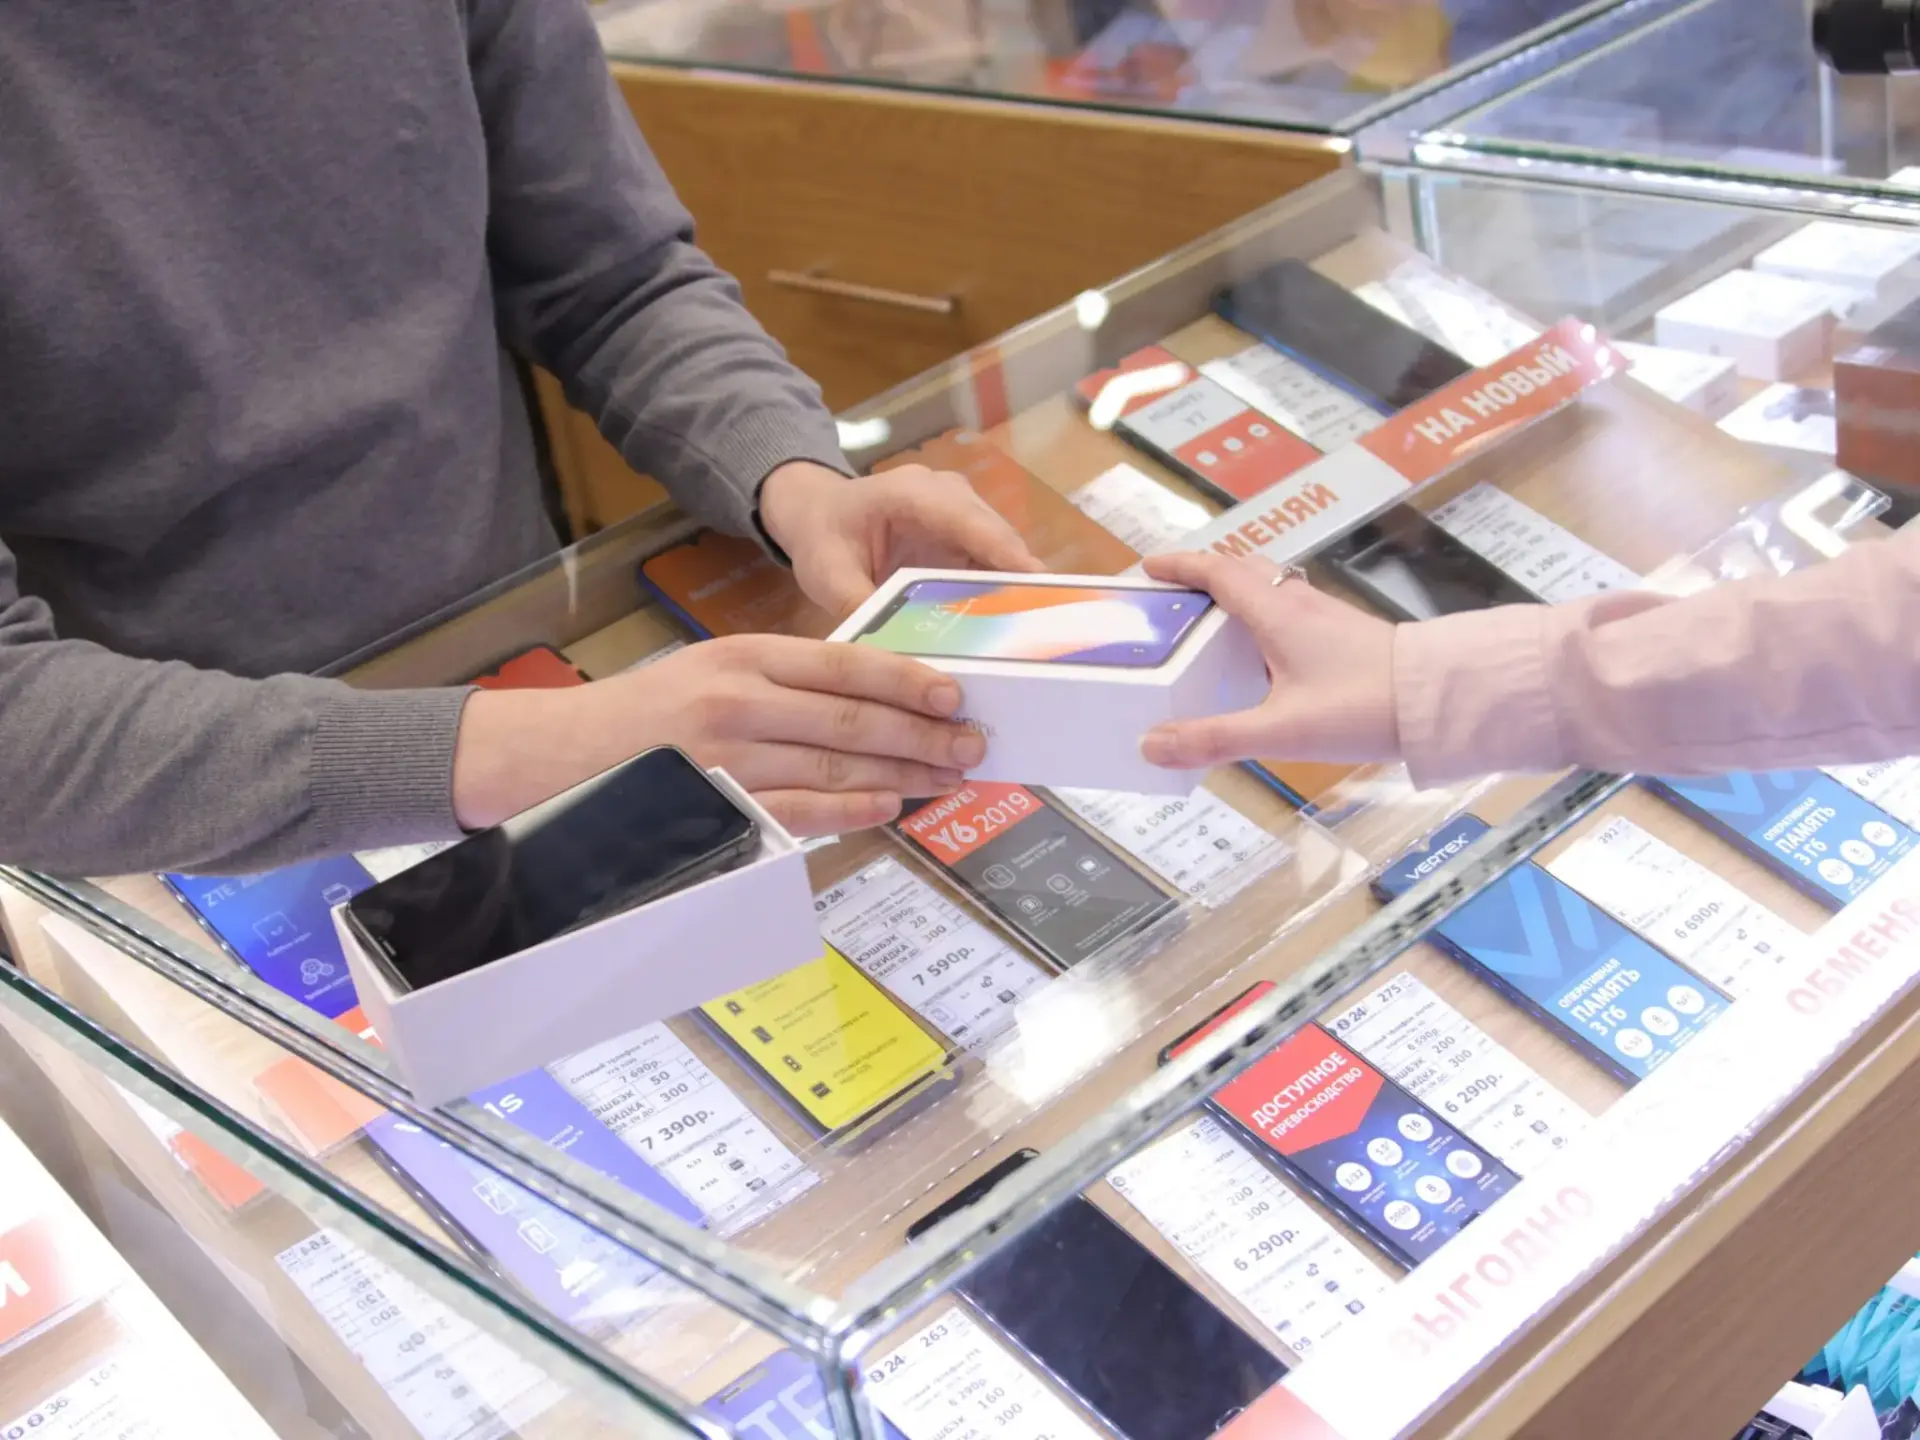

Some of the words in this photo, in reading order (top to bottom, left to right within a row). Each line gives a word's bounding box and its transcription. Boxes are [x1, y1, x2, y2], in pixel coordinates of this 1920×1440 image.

[1413, 407, 1475, 444] НА
[1463, 343, 1582, 417] НОВЫЙ
[1203, 483, 1341, 558] МЕНЯЙ
[910, 788, 978, 833] HUAWEI
[927, 820, 978, 852] Y6
[972, 791, 1031, 833] 2019
[1763, 796, 1818, 841] ОПЕРАТИВНАЯ
[1774, 807, 1837, 854] ПАМЯТЬ
[1404, 835, 1469, 880] VERTEX
[1793, 853, 1813, 866] 3
[202, 883, 237, 908] ZTE
[856, 933, 900, 964] КЭШБЭК
[909, 915, 928, 930] 20
[1674, 928, 1689, 939] 6
[1684, 900, 1726, 932] 690р.
[868, 943, 909, 973] СКИДКА
[912, 974, 925, 987] 7
[927, 947, 976, 978] 590р.
[1348, 1007, 1366, 1023] 24
[1376, 983, 1402, 1003] 275
[1558, 957, 1622, 1008] ОПЕРАТИВНАЯ
[1569, 969, 1642, 1023] ПАМЯТЬ
[1589, 1021, 1609, 1036] 3
[1394, 1056, 1427, 1082] ЭШБЭК
[1432, 1035, 1456, 1055] 200
[1407, 1068, 1438, 1091] КИДКА
[1448, 1048, 1473, 1069] 300
[594, 1089, 637, 1117] ЭШБЭК
[650, 1070, 671, 1086] 50
[604, 1100, 644, 1129] КИДКА
[659, 1082, 690, 1103] 300
[1251, 1051, 1349, 1130] ДОСТУПНОЕ
[1269, 1066, 1364, 1140] ПРЕВОСХОДСТВО
[1445, 1100, 1460, 1114] 6
[1456, 1073, 1504, 1105] 290р.
[640, 1135, 654, 1150] 7
[658, 1109, 716, 1141] 390р.
[1405, 1119, 1422, 1132] 16
[1226, 1185, 1253, 1207] 200
[1233, 1256, 1249, 1271] 6
[1248, 1228, 1301, 1262] 290р.
[1388, 1185, 1595, 1357] ЫГОДНО
[884, 1354, 905, 1374] 24
[919, 1323, 950, 1348] 263
[1292, 1336, 1312, 1351] OS
[977, 1386, 1007, 1411] 160
[994, 1402, 1024, 1427] 300
